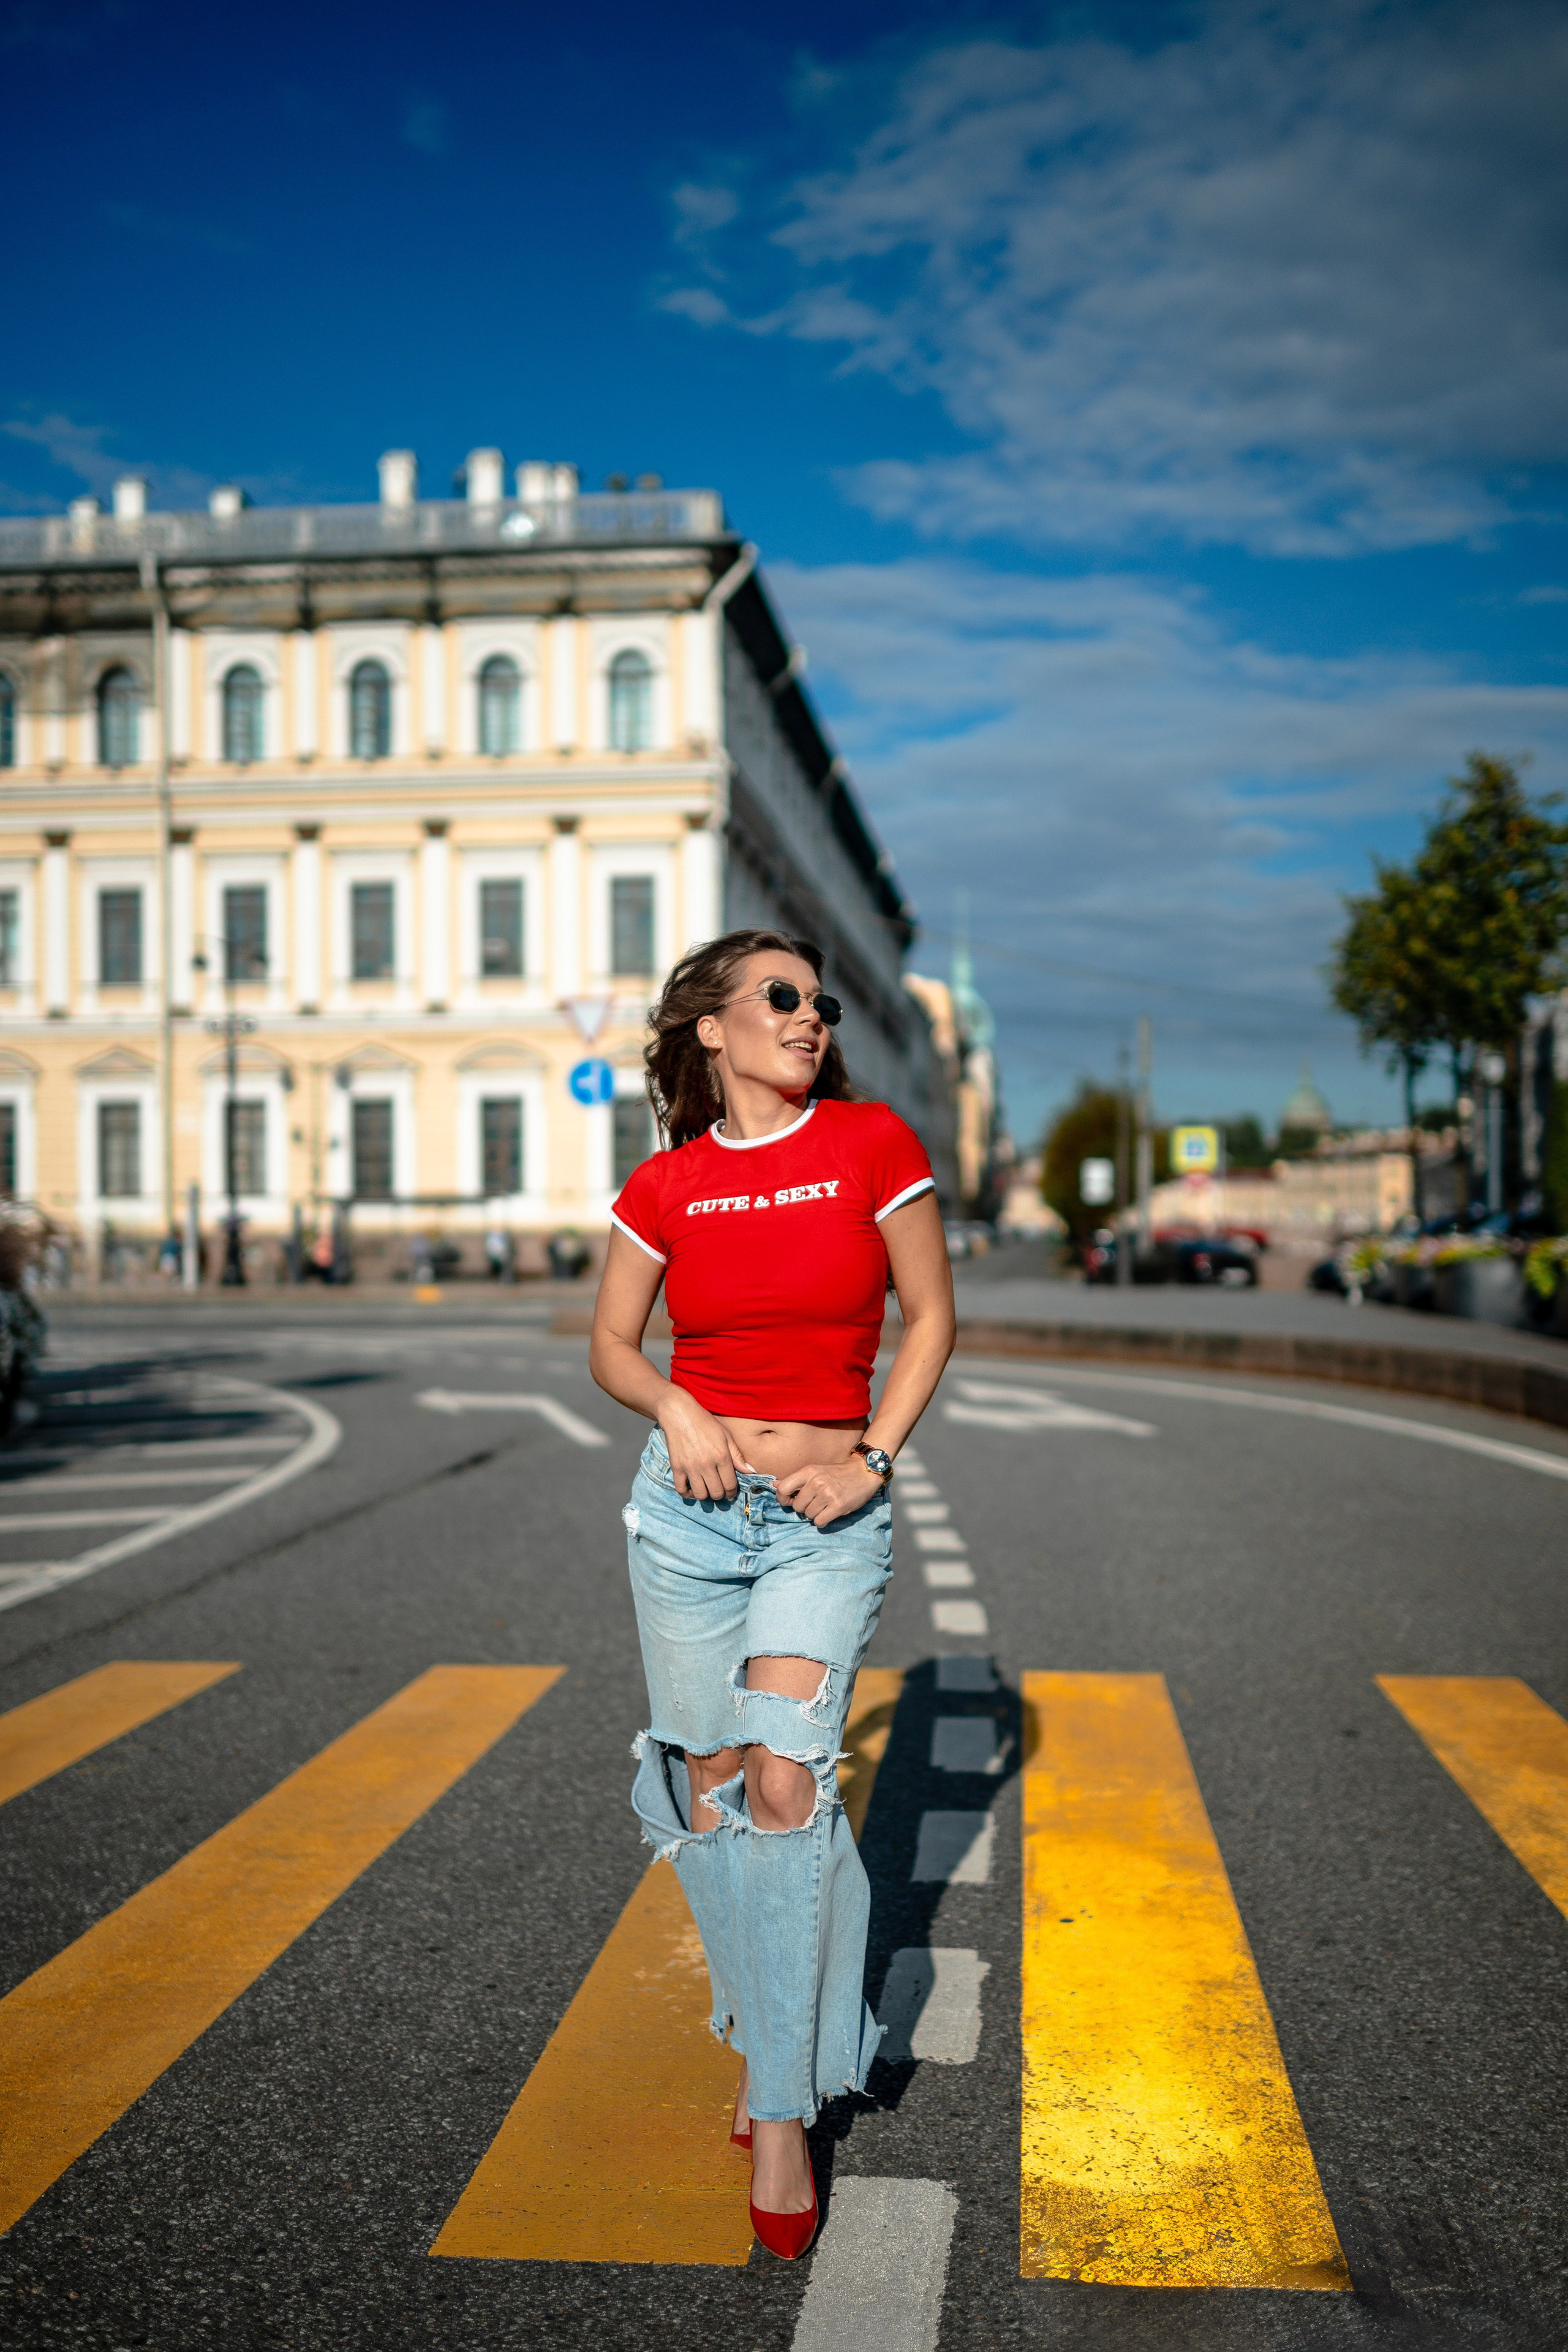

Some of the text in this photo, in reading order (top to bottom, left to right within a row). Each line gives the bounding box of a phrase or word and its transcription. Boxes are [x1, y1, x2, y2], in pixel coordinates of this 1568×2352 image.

[686, 1180, 840, 1216] CUTE & SEXY
